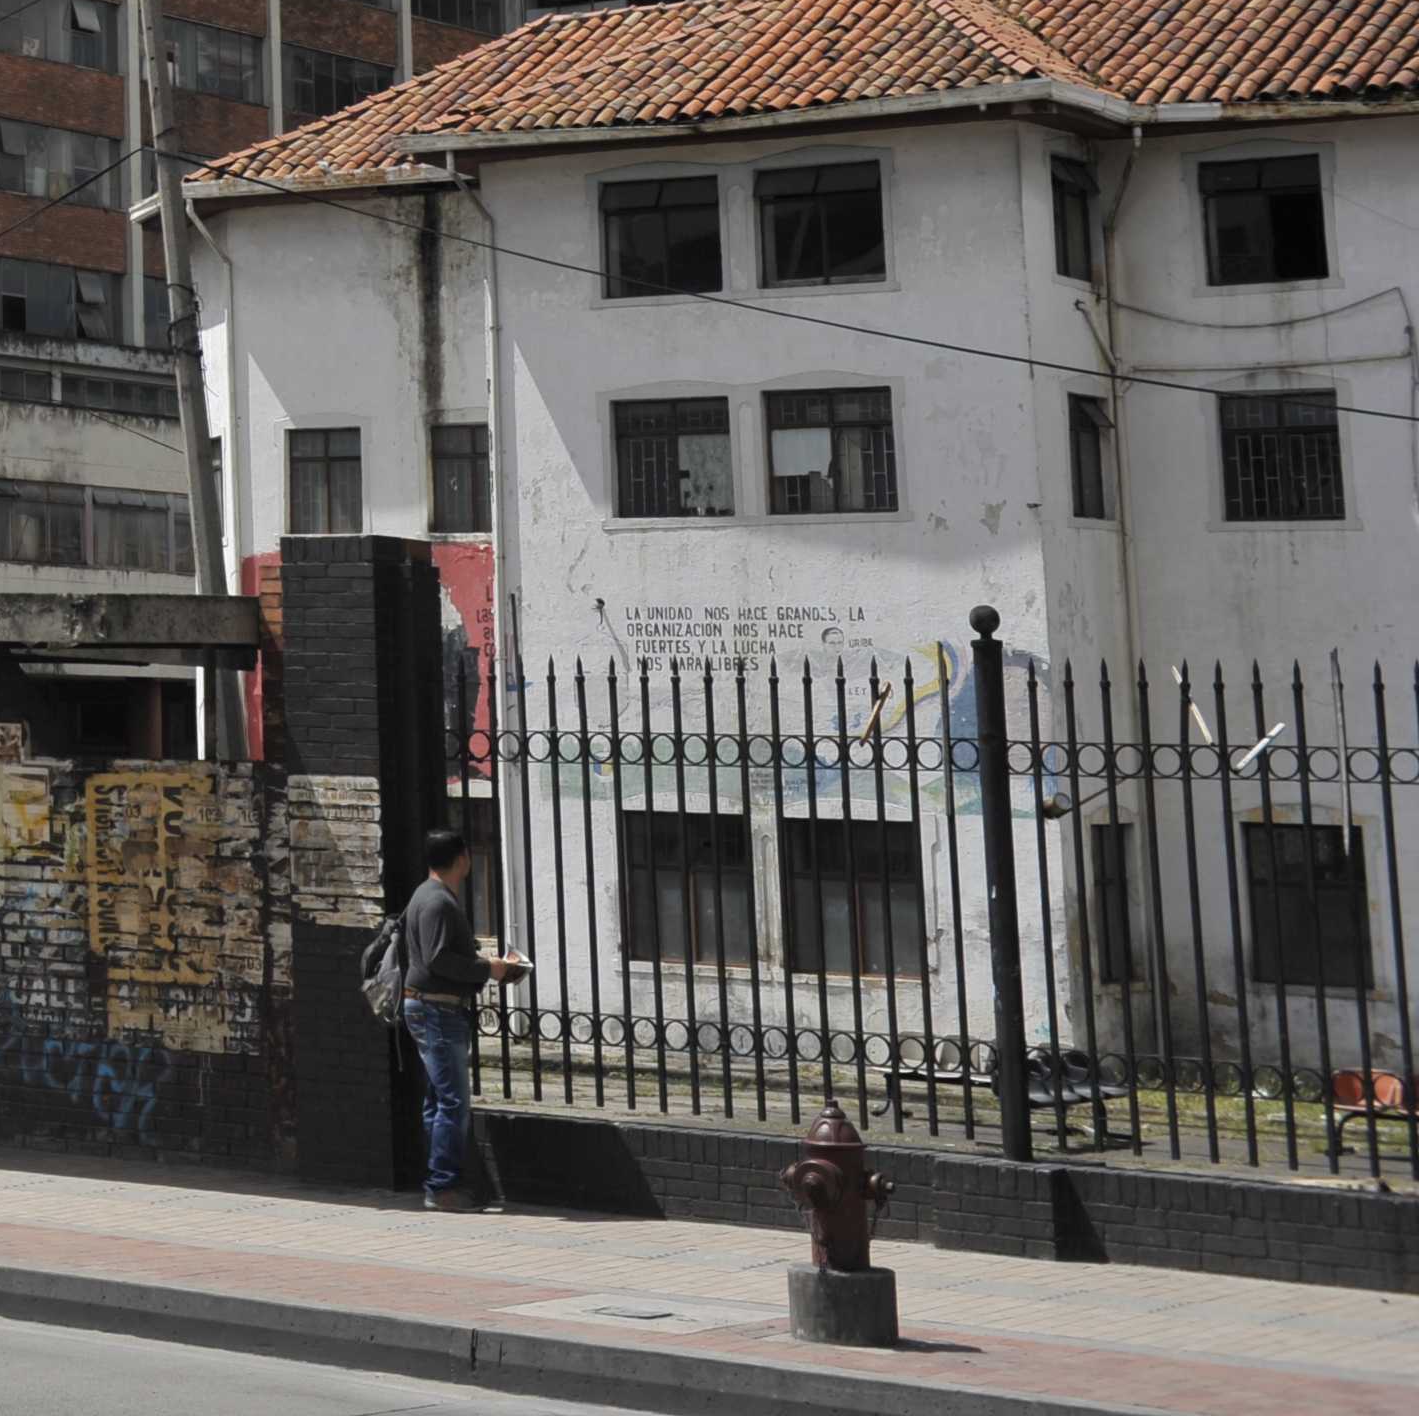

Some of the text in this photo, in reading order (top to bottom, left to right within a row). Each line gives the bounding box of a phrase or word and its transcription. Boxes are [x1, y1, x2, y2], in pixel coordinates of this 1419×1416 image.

[625, 606, 641, 621] LA
[647, 606, 693, 621] UNIDAD
[704, 606, 730, 621] NOS
[738, 606, 768, 621] HACE
[849, 606, 866, 622] LA
[733, 623, 759, 638] NOS
[768, 623, 805, 639] HACE
[635, 639, 776, 657] FUERTES, Y LA LUCHA
[848, 638, 874, 649] URIBE
[848, 686, 868, 696] LEY
